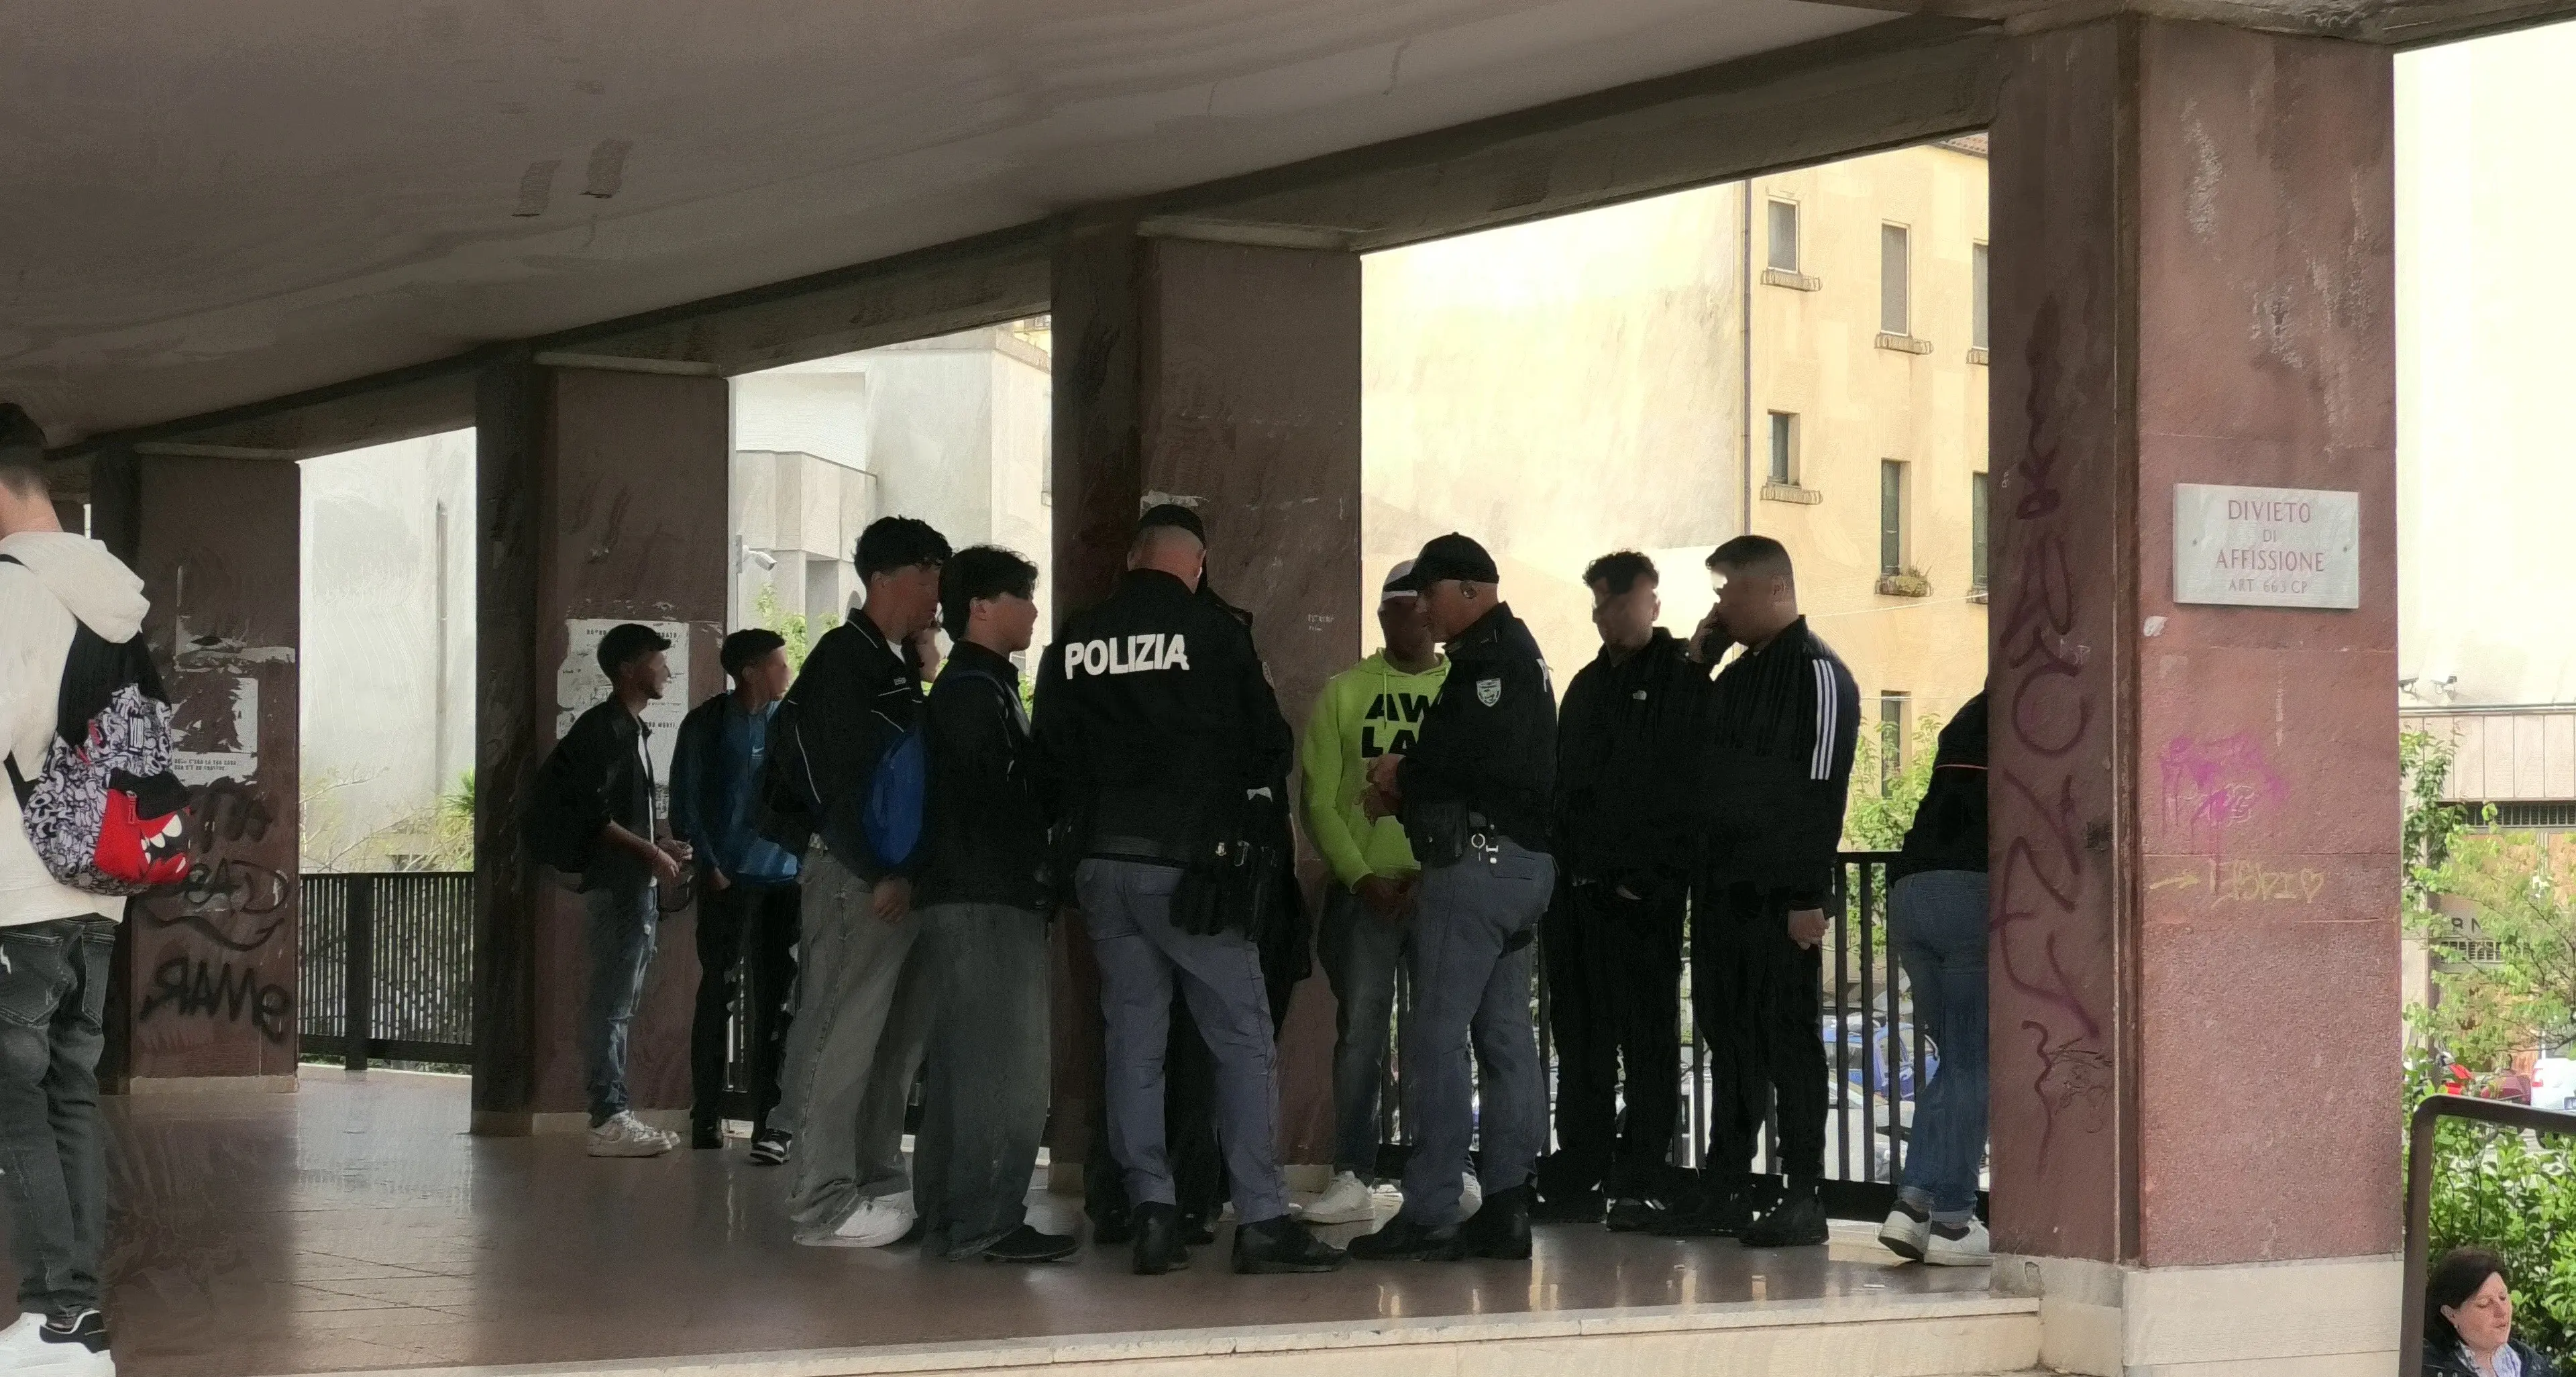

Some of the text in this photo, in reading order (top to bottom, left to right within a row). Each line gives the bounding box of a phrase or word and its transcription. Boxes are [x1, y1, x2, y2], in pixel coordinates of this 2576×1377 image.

[2228, 500, 2310, 523] DIVIETO
[2263, 529, 2276, 543] DI
[2215, 549, 2325, 571] AFFISSIONE
[2263, 579, 2286, 594] 663
[2291, 580, 2308, 594] CP
[1065, 633, 1190, 679] POLIZIA
